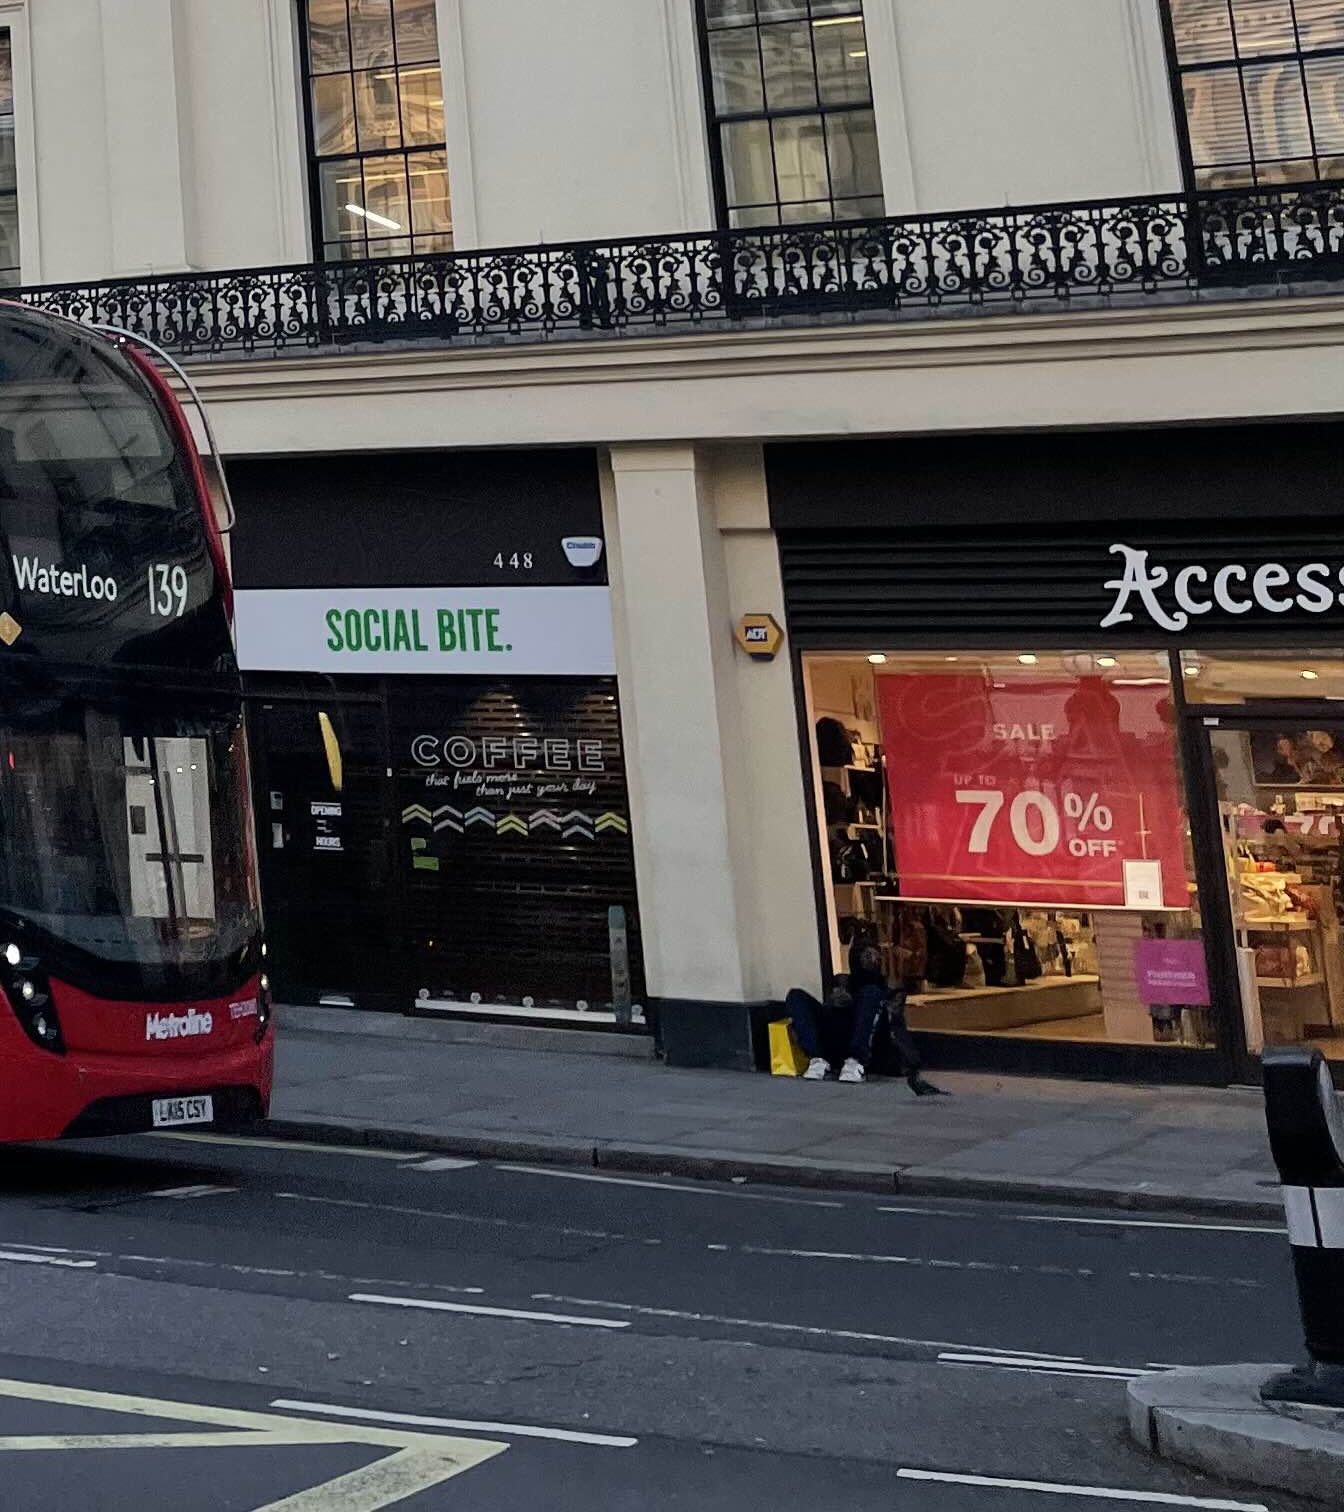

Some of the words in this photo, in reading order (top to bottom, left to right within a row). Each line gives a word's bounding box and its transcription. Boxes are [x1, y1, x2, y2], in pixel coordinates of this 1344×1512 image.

[493, 552, 533, 569] 448
[12, 554, 118, 601] Waterloo
[148, 564, 188, 617] 139
[1100, 543, 1344, 632] Acces
[326, 609, 428, 651] SOCIAL
[437, 609, 512, 651] BITE.
[993, 724, 1056, 740] SALE
[412, 735, 605, 771] COFFEE
[425, 773, 449, 786] that
[454, 770, 483, 789] fuels
[486, 773, 517, 783] more
[476, 785, 505, 796] than
[507, 783, 531, 799] just
[537, 784, 568, 797] your
[572, 778, 596, 795] day
[954, 775, 973, 785] UP
[978, 774, 996, 785] TO
[1069, 839, 1117, 857] OFF
[146, 1008, 213, 1041] Metroline
